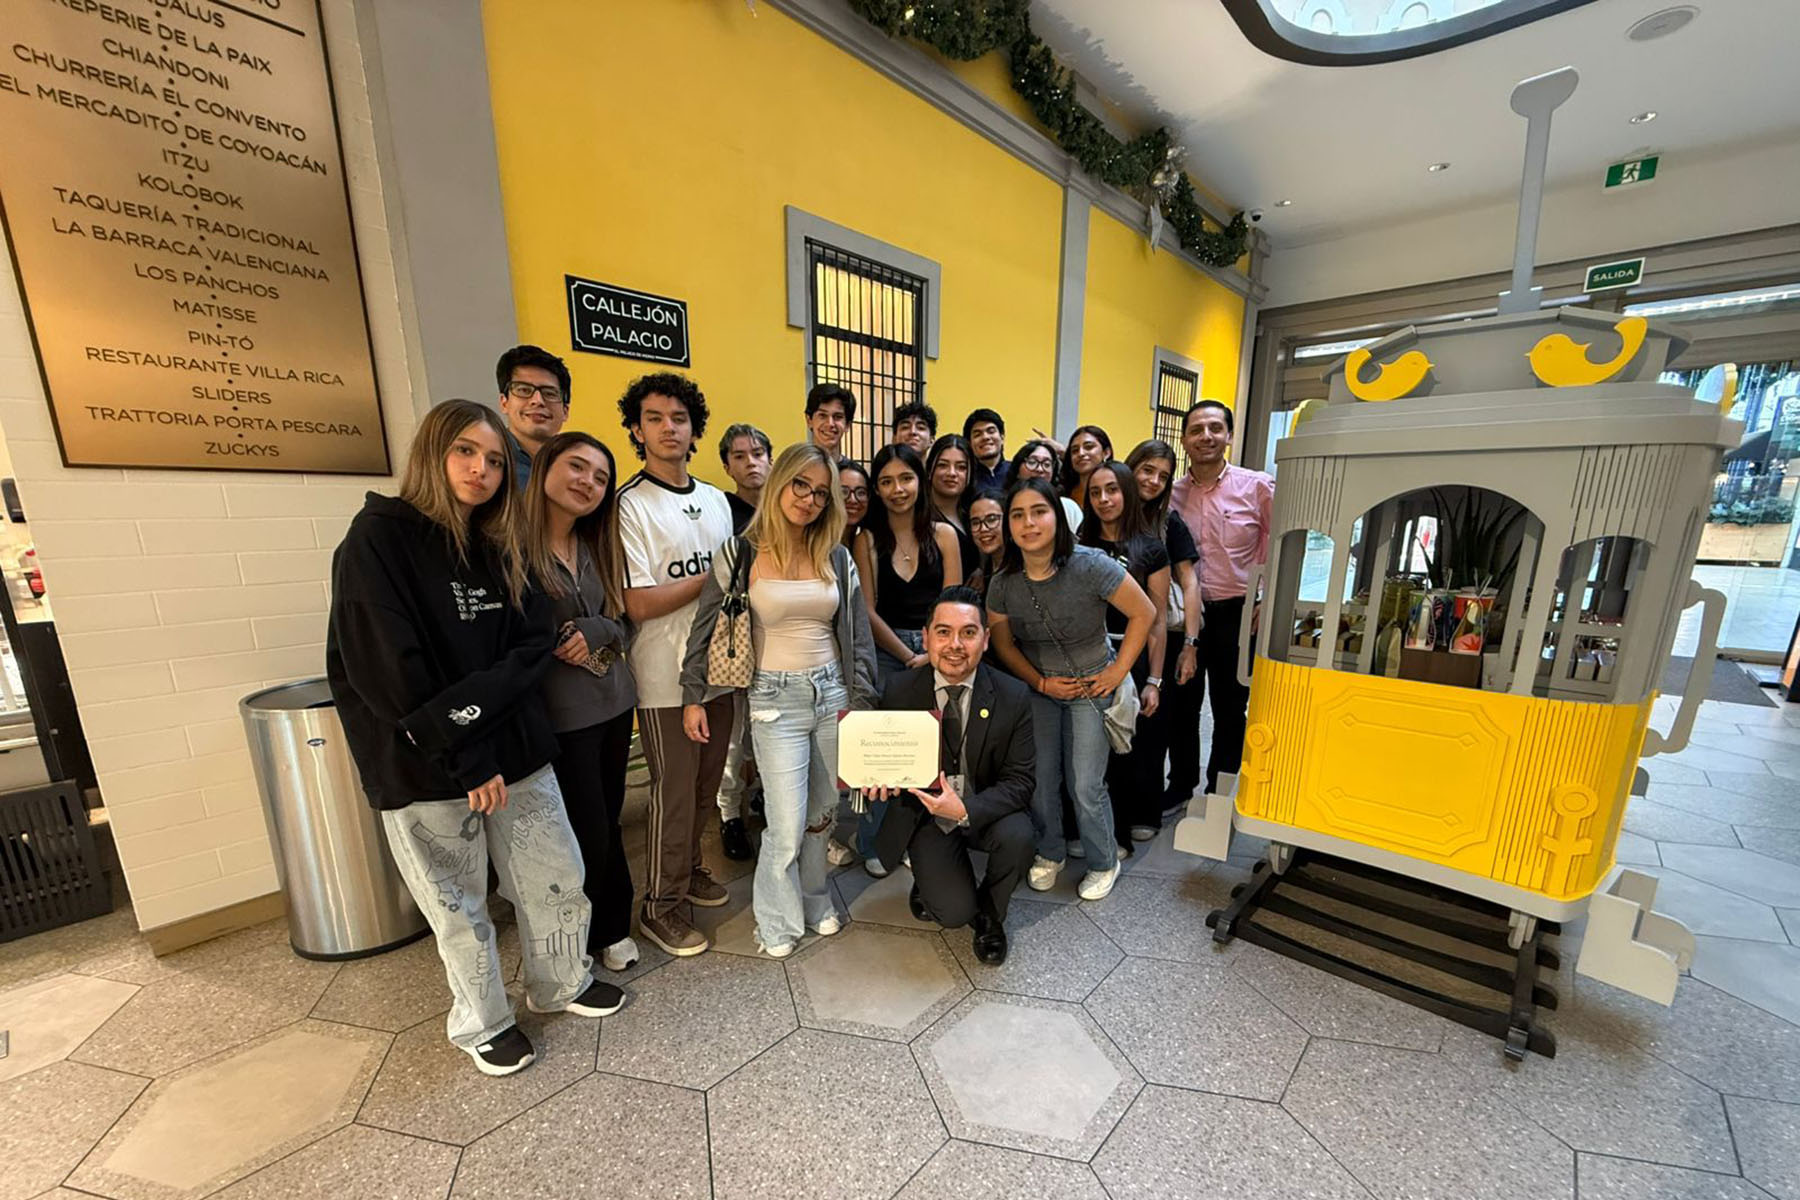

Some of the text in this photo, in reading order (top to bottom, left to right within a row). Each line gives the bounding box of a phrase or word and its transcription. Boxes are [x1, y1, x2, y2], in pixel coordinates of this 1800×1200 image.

[101, 37, 230, 91] CHIANDONI
[156, 23, 189, 48] DE
[192, 35, 223, 59] LA
[225, 46, 273, 76] PAIX
[12, 43, 307, 143] CHURRERÍA EL CONVENTO
[0, 72, 328, 176] EL MERCADITO DE COYOACÁN
[161, 148, 210, 174] ITZU
[137, 172, 244, 211] KOLOBOK
[52, 186, 321, 256] TAQUERÍA TRADICIONAL
[51, 216, 330, 283] LA BARRACA VALENCIANA
[134, 262, 280, 300] LOS PANCHOS
[1593, 269, 1634, 282] SALIDA
[172, 298, 258, 325] MATISSE
[582, 293, 678, 327] CALLEJÓN
[591, 322, 672, 351] PALACIO
[85, 346, 345, 387] RESTAURANTE VILLA RICA
[191, 385, 272, 405] SLIDERS
[84, 405, 363, 437] TRATTORIA PORTA PESCARA
[204, 441, 280, 458] ZUCKYS
